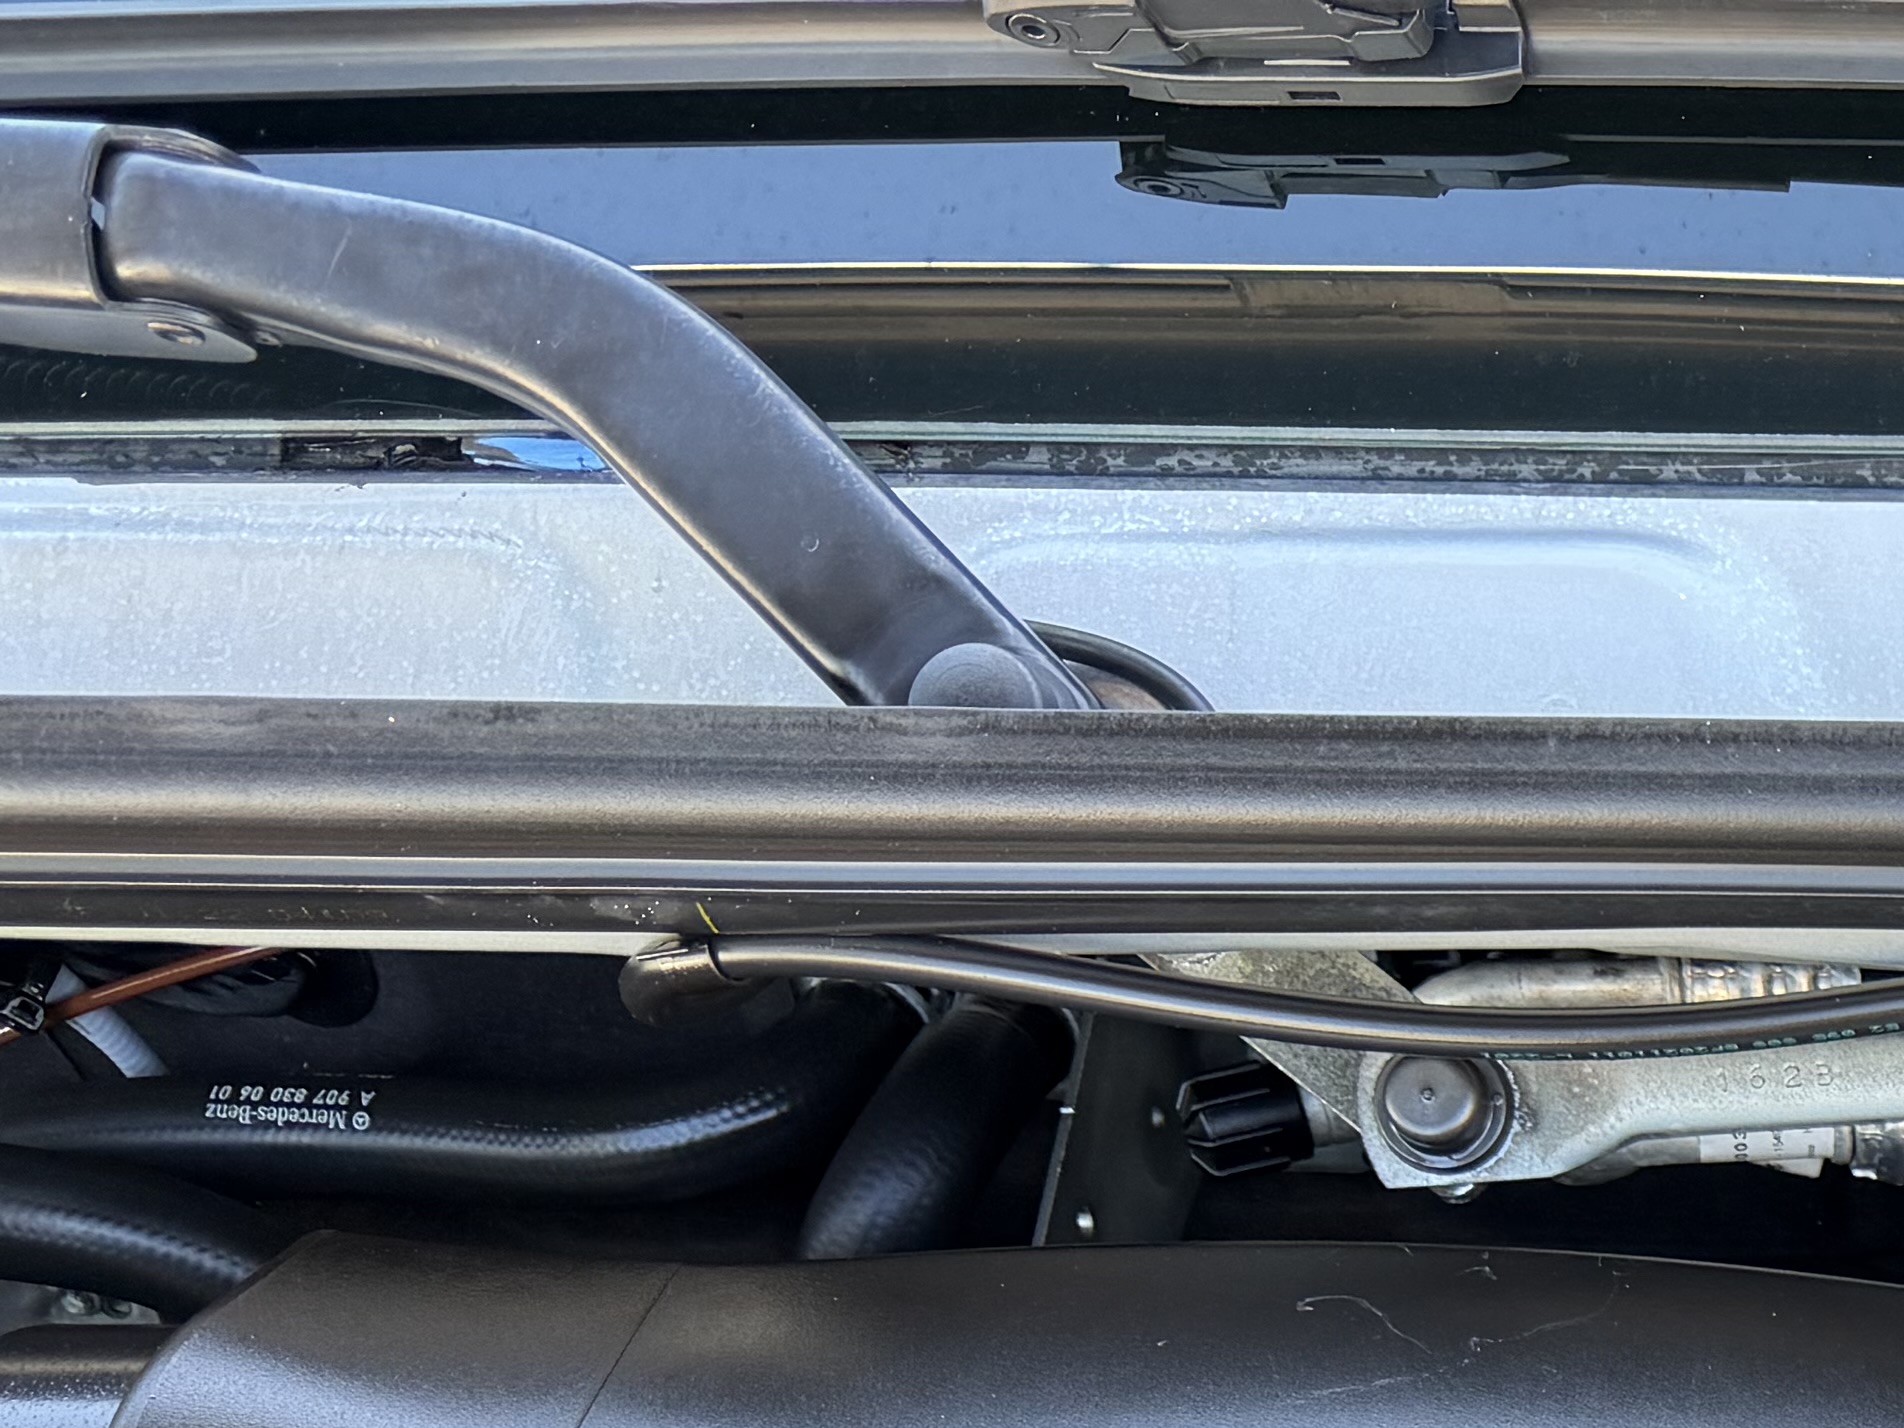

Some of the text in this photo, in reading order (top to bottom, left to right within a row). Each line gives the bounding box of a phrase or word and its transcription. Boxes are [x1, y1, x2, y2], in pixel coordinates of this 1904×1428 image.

[209, 1084, 375, 1106] A 907 830 06 01
[204, 1102, 346, 1129] Mercedes-Benz
